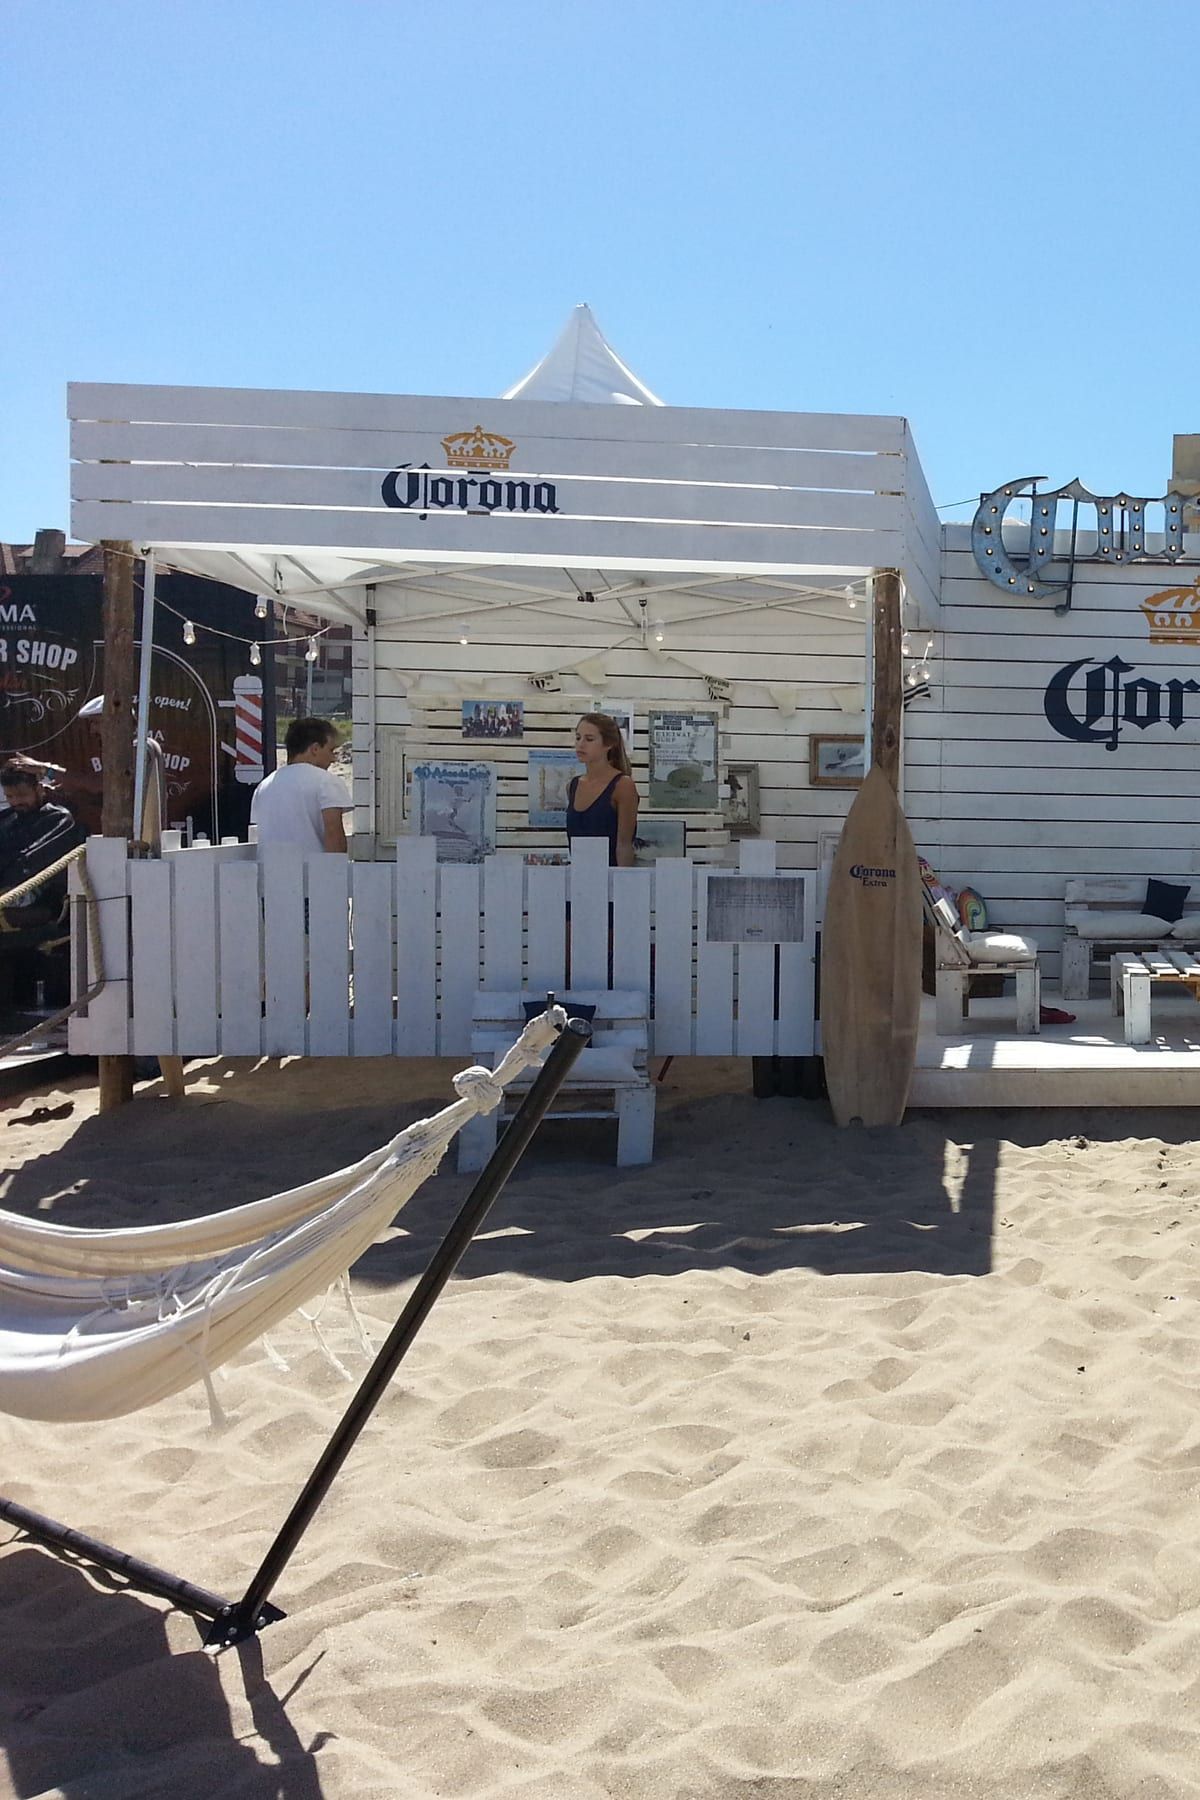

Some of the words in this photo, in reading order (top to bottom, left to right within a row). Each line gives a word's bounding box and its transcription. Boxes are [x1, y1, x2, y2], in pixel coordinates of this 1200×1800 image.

[381, 462, 560, 520] Corona
[16, 639, 78, 672] SHOP
[154, 695, 192, 711] open!
[162, 752, 191, 772] HOP
[849, 864, 897, 880] Corona
[862, 877, 888, 887] Extra
